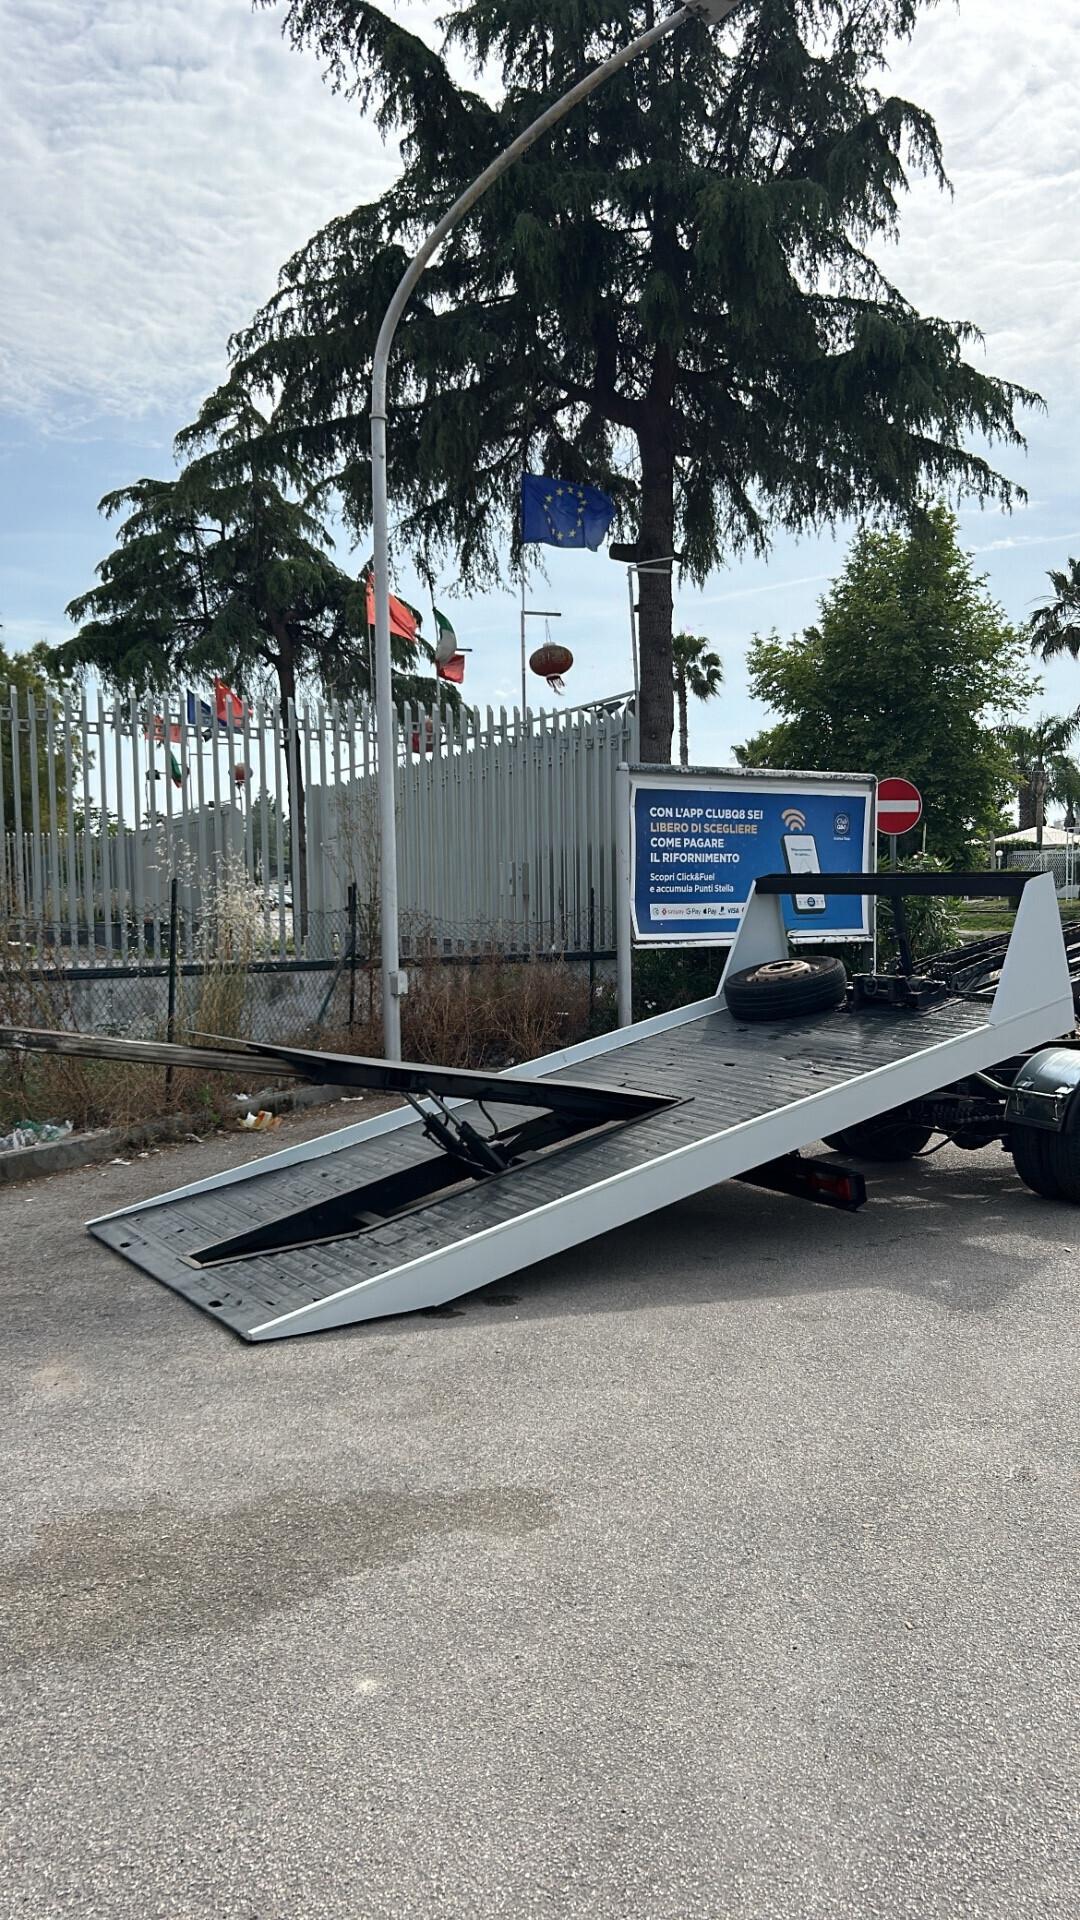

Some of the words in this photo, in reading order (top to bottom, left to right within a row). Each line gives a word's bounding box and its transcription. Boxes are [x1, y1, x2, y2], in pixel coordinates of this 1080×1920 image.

[649, 807, 673, 818] CON
[705, 808, 745, 819] CLUBQ8
[747, 809, 764, 820] SEI
[650, 822, 689, 833] LIBERO
[690, 823, 701, 833] DI
[703, 823, 758, 834] SCEGLIERE
[650, 837, 681, 848] COME
[683, 838, 725, 848] PAGARE
[650, 852, 660, 863] IL
[662, 852, 740, 863] RIFORNIMENTO
[649, 872, 675, 882] Scopri
[676, 872, 715, 881] Click&Fuel
[656, 884, 693, 893] accumula
[694, 884, 713, 893] Punti
[714, 884, 734, 893] Stella
